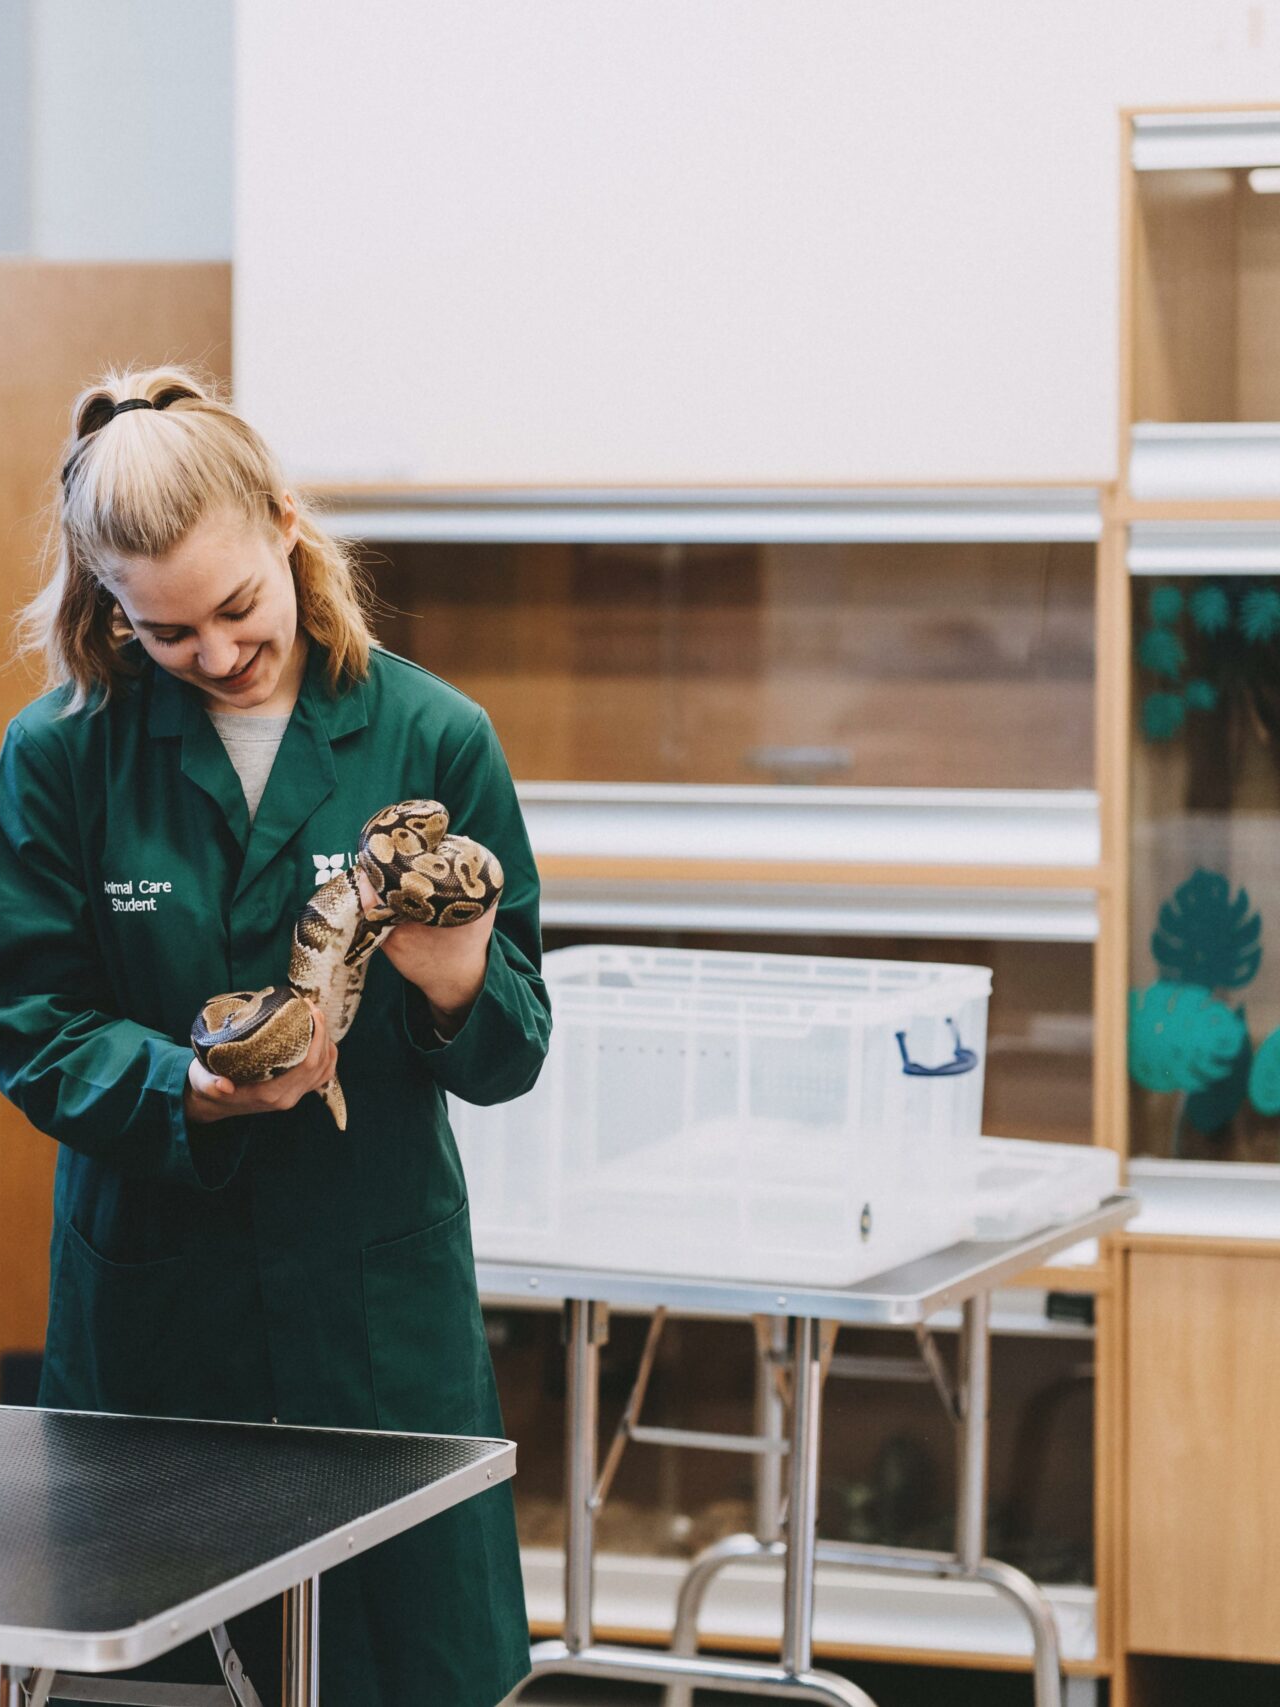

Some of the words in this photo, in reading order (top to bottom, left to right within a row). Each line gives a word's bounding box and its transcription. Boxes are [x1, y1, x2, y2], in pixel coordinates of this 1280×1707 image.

[104, 880, 133, 895] Animal
[139, 880, 172, 894] Care
[112, 897, 157, 912] Student
